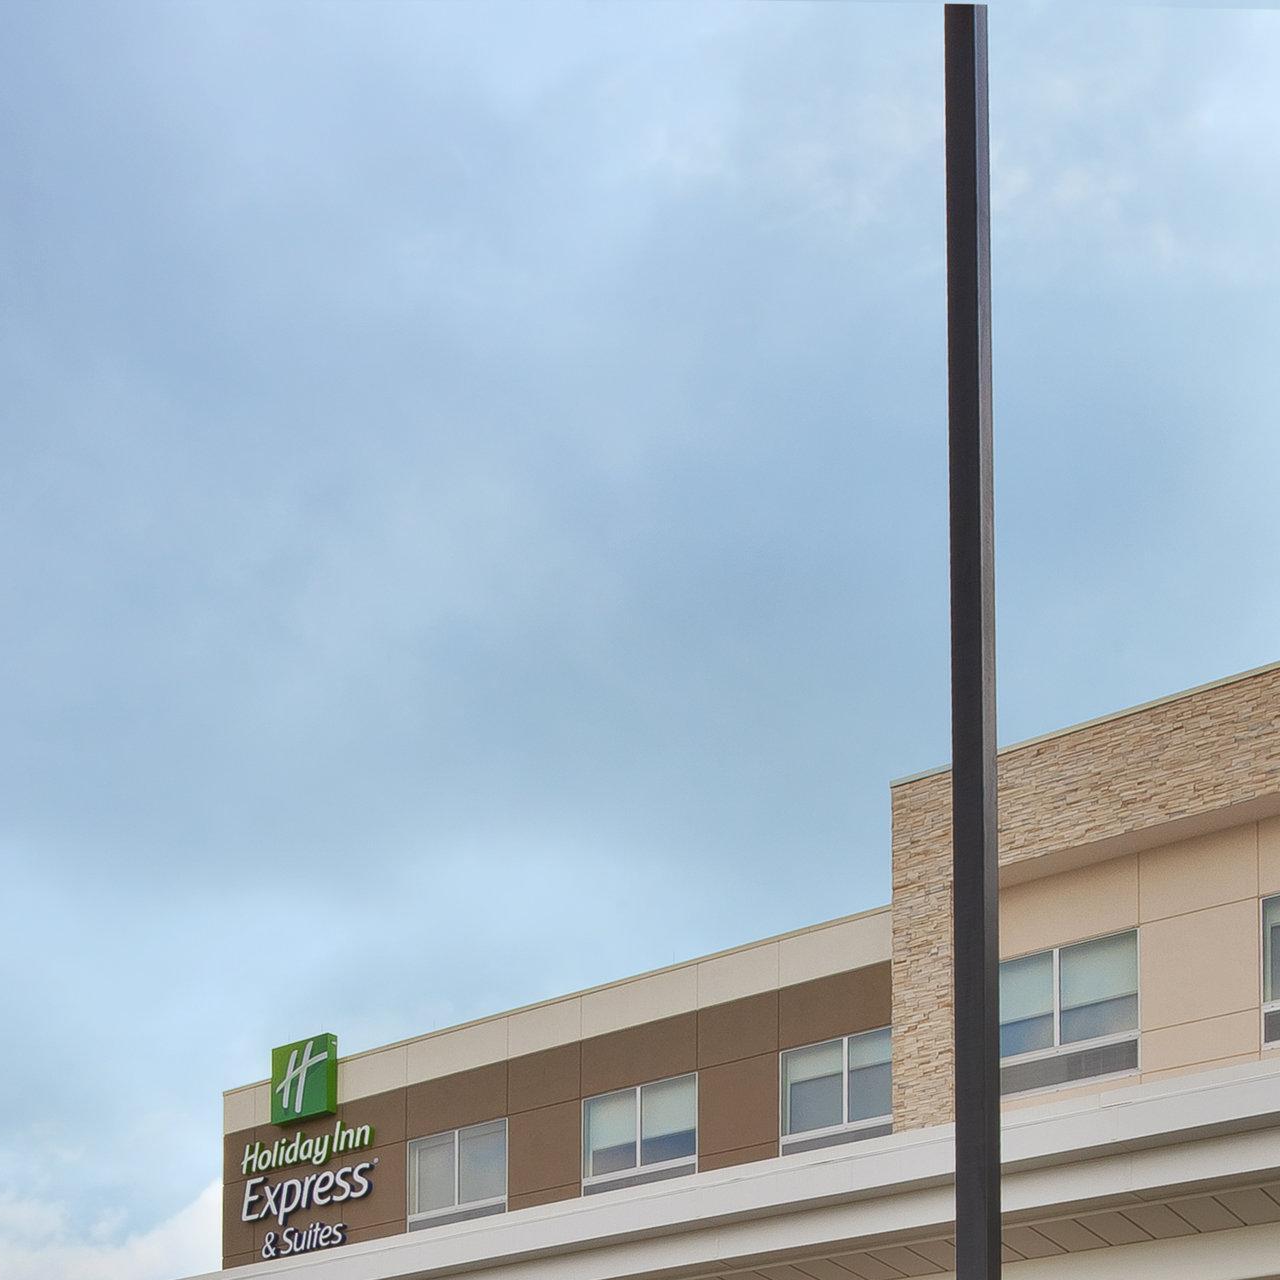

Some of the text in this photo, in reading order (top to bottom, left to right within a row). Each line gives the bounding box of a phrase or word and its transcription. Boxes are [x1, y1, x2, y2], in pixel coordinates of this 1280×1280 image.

[240, 1120, 371, 1175] Holiday Inn
[240, 1162, 371, 1226] Express
[261, 1221, 344, 1259] & Suites
